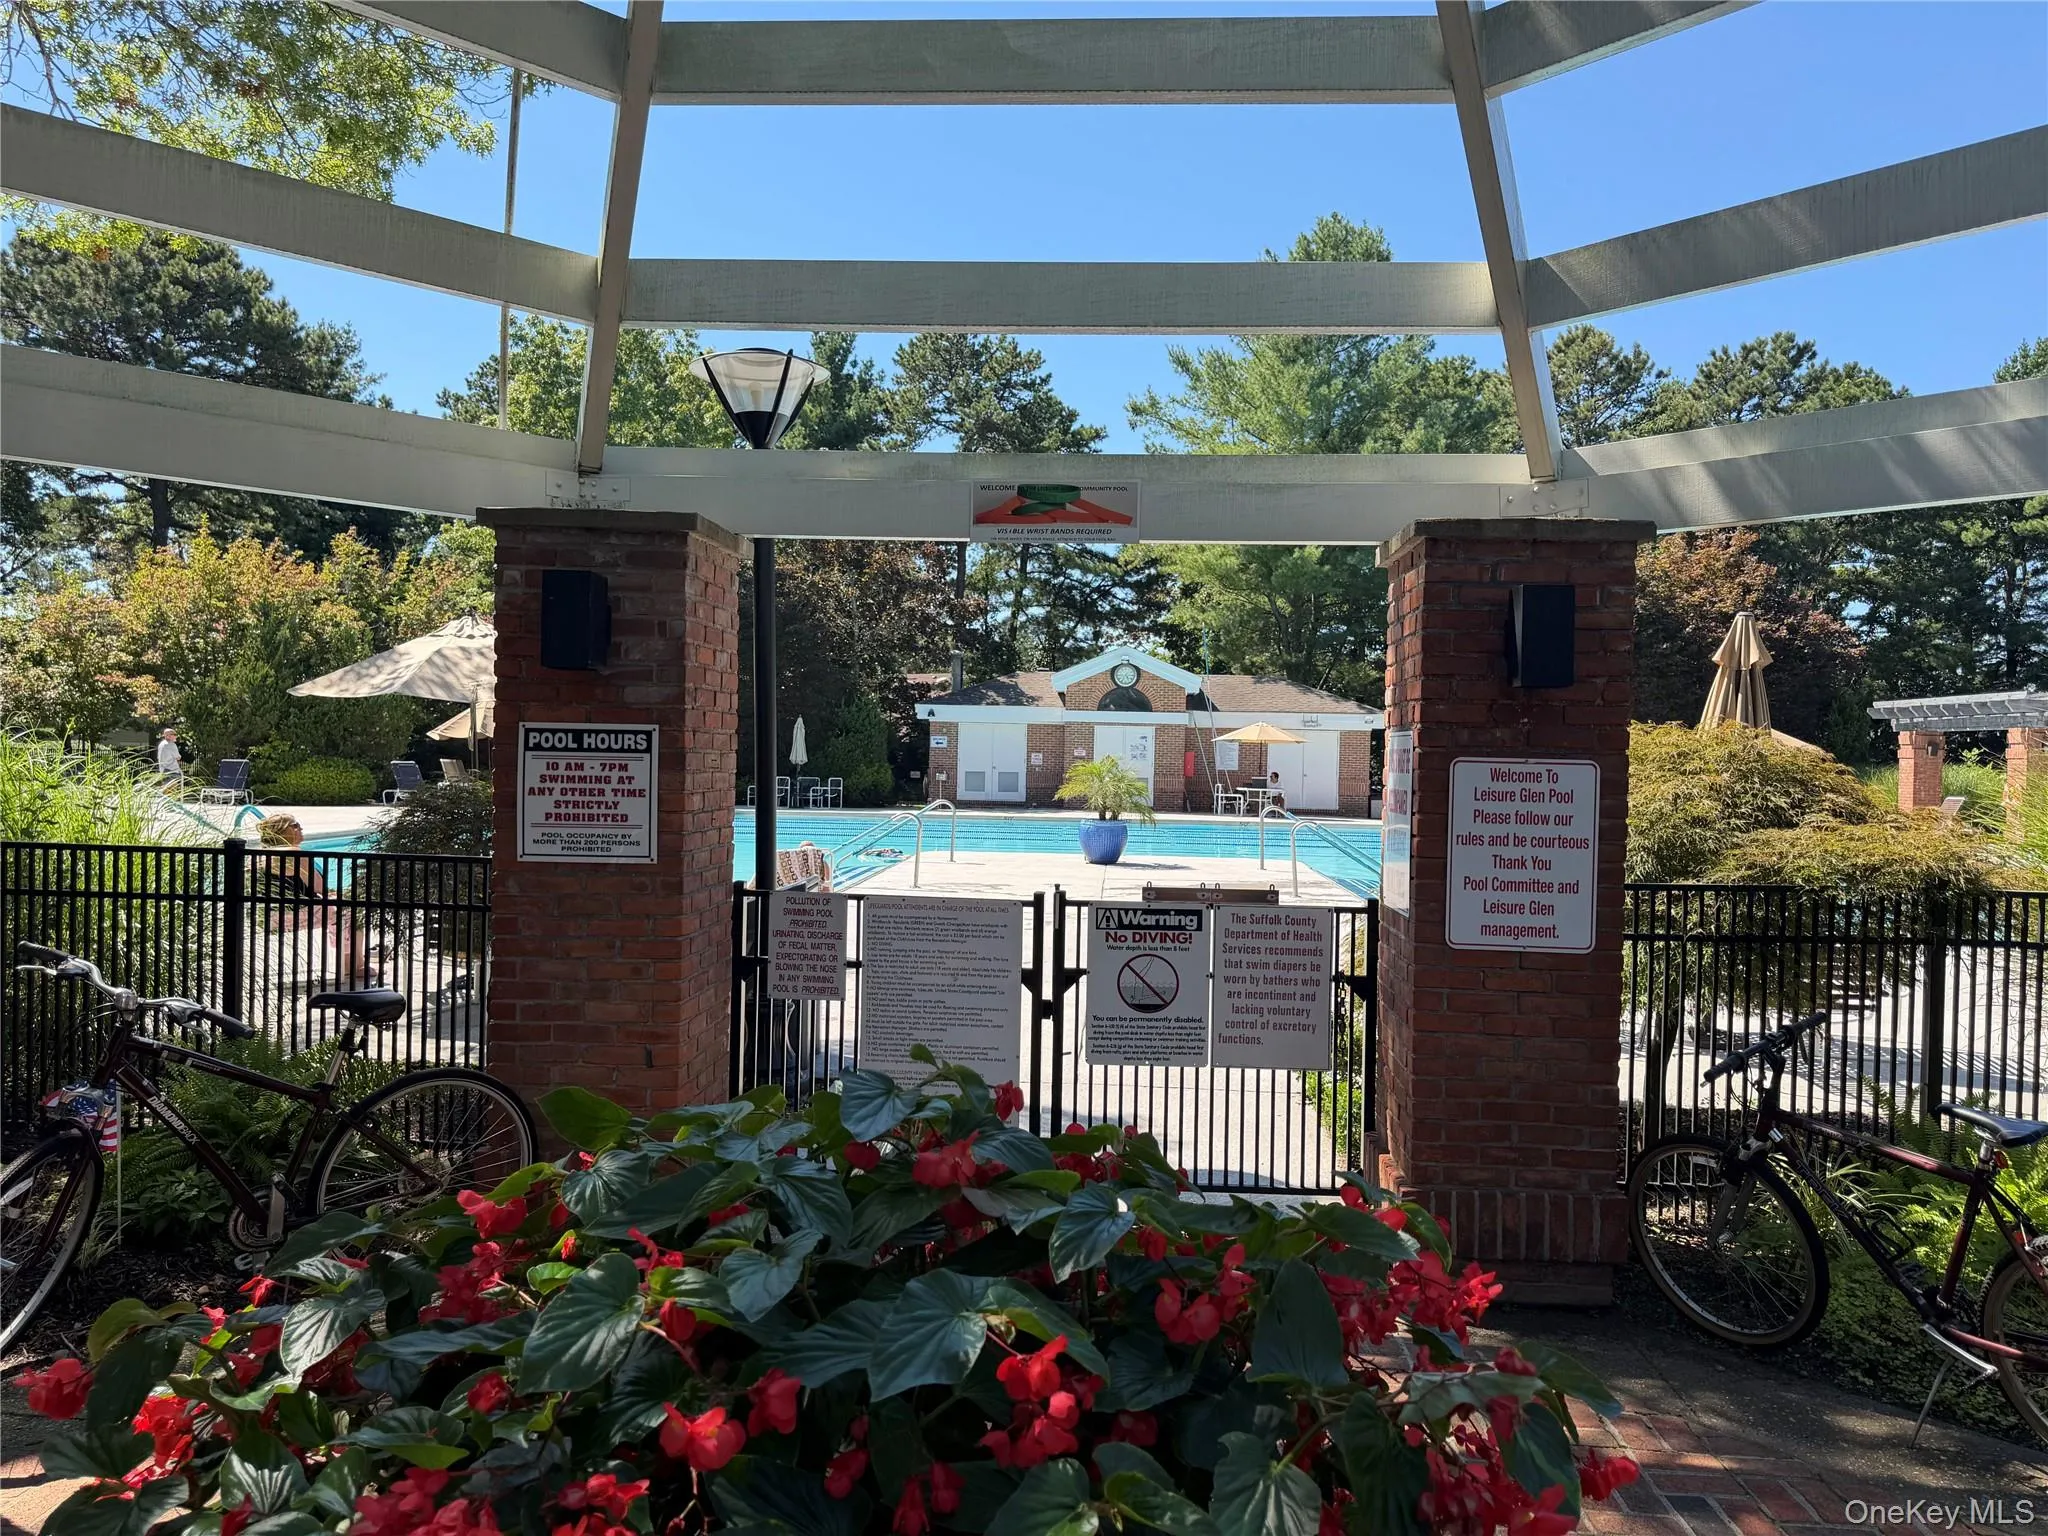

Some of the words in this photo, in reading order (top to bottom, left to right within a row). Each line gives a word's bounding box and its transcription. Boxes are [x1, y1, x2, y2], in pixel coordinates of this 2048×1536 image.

[528, 732, 578, 748] POOL
[583, 733, 647, 749] HOURS
[546, 762, 560, 770] 10
[564, 762, 585, 771] AM
[600, 763, 629, 772] 7PM
[539, 774, 612, 784] SWIMMING
[617, 776, 635, 784] AT
[1490, 767, 1543, 783] Welcome
[1546, 769, 1559, 784] To
[527, 787, 555, 796] ANY
[560, 787, 606, 796] OTHER
[611, 788, 646, 797] TIME
[1474, 787, 1516, 802] Leisure
[1520, 788, 1545, 802] Glen
[1549, 788, 1574, 803] Pool
[553, 800, 620, 809] STRICTLY
[544, 812, 629, 822] PROHIBITED
[1473, 809, 1511, 824] Please
[1515, 810, 1551, 825] follow
[1554, 814, 1574, 826] our
[1456, 832, 1485, 846] rules
[1488, 833, 1510, 846] and
[1513, 834, 1527, 847] be
[1530, 834, 1590, 849] courteous
[1492, 854, 1528, 869] Thank
[1531, 856, 1552, 870] You
[1463, 876, 1488, 891] Pool
[1491, 877, 1554, 893] Committee
[1557, 879, 1579, 894] and
[786, 897, 821, 905] POLLUTION
[1483, 899, 1525, 914] Leisure
[1529, 900, 1554, 915] Glen
[783, 908, 814, 916] SWIMMING
[816, 909, 834, 917] POOL
[1120, 910, 1198, 929] Warning
[1231, 913, 1247, 924] The
[1249, 913, 1282, 925] Suffolk
[1285, 915, 1317, 927] County
[807, 931, 843, 940] DISCHARGE
[1105, 932, 1128, 942] No
[1132, 932, 1192, 944] DIVING!
[1224, 928, 1278, 941] Department
[1280, 930, 1290, 940] of
[1293, 930, 1323, 941] Health
[1480, 924, 1559, 940] management.
[788, 942, 808, 950] FECAL
[1222, 944, 1262, 954] Services
[1264, 945, 1324, 956] recommends
[776, 952, 827, 961] EXPECTORATING
[775, 963, 804, 971] BLOWING
[820, 965, 838, 973] NOSE
[1224, 959, 1243, 968] that
[1246, 960, 1270, 969] swim
[1273, 960, 1307, 973] diapers
[1310, 961, 1322, 972] be
[803, 975, 834, 984] SWIMMING
[1224, 976, 1247, 984] worn
[1249, 975, 1261, 986] by
[1263, 975, 1298, 986] bathers
[1301, 976, 1321, 987] who
[1245, 990, 1297, 1000] incontinent
[1299, 991, 1317, 1001] and
[1232, 1003, 1264, 1017] lacking
[1267, 1004, 1311, 1018] voluntary
[1225, 1020, 1258, 1029] control
[1260, 1020, 1270, 1029] of
[1272, 1021, 1317, 1034] excretory
[1218, 1033, 1264, 1044] functions.
[148, 1096, 200, 1144] DIAMONDBACK
